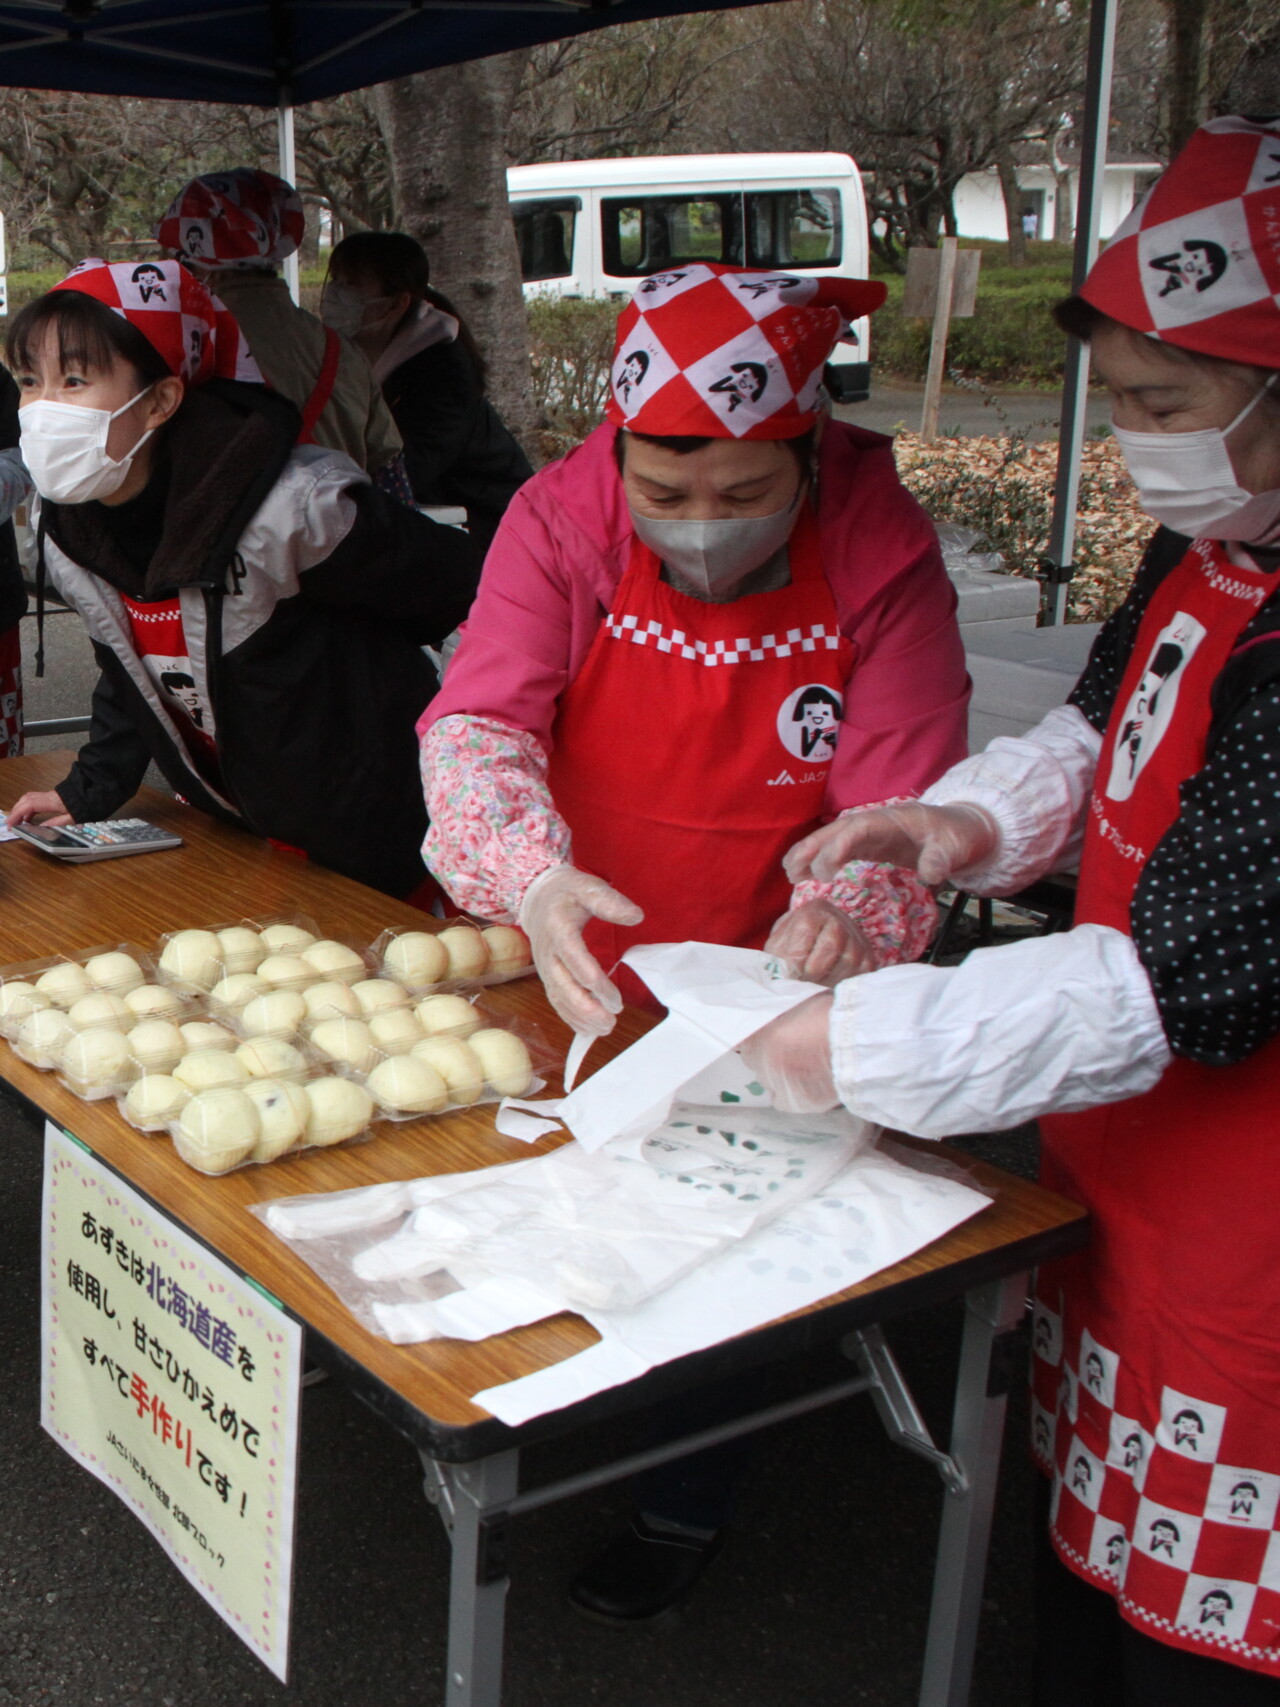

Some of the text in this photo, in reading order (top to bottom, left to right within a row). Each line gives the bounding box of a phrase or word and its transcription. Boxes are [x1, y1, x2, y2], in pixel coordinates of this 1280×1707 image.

[81, 1211, 256, 1383] あずきは北海道産を
